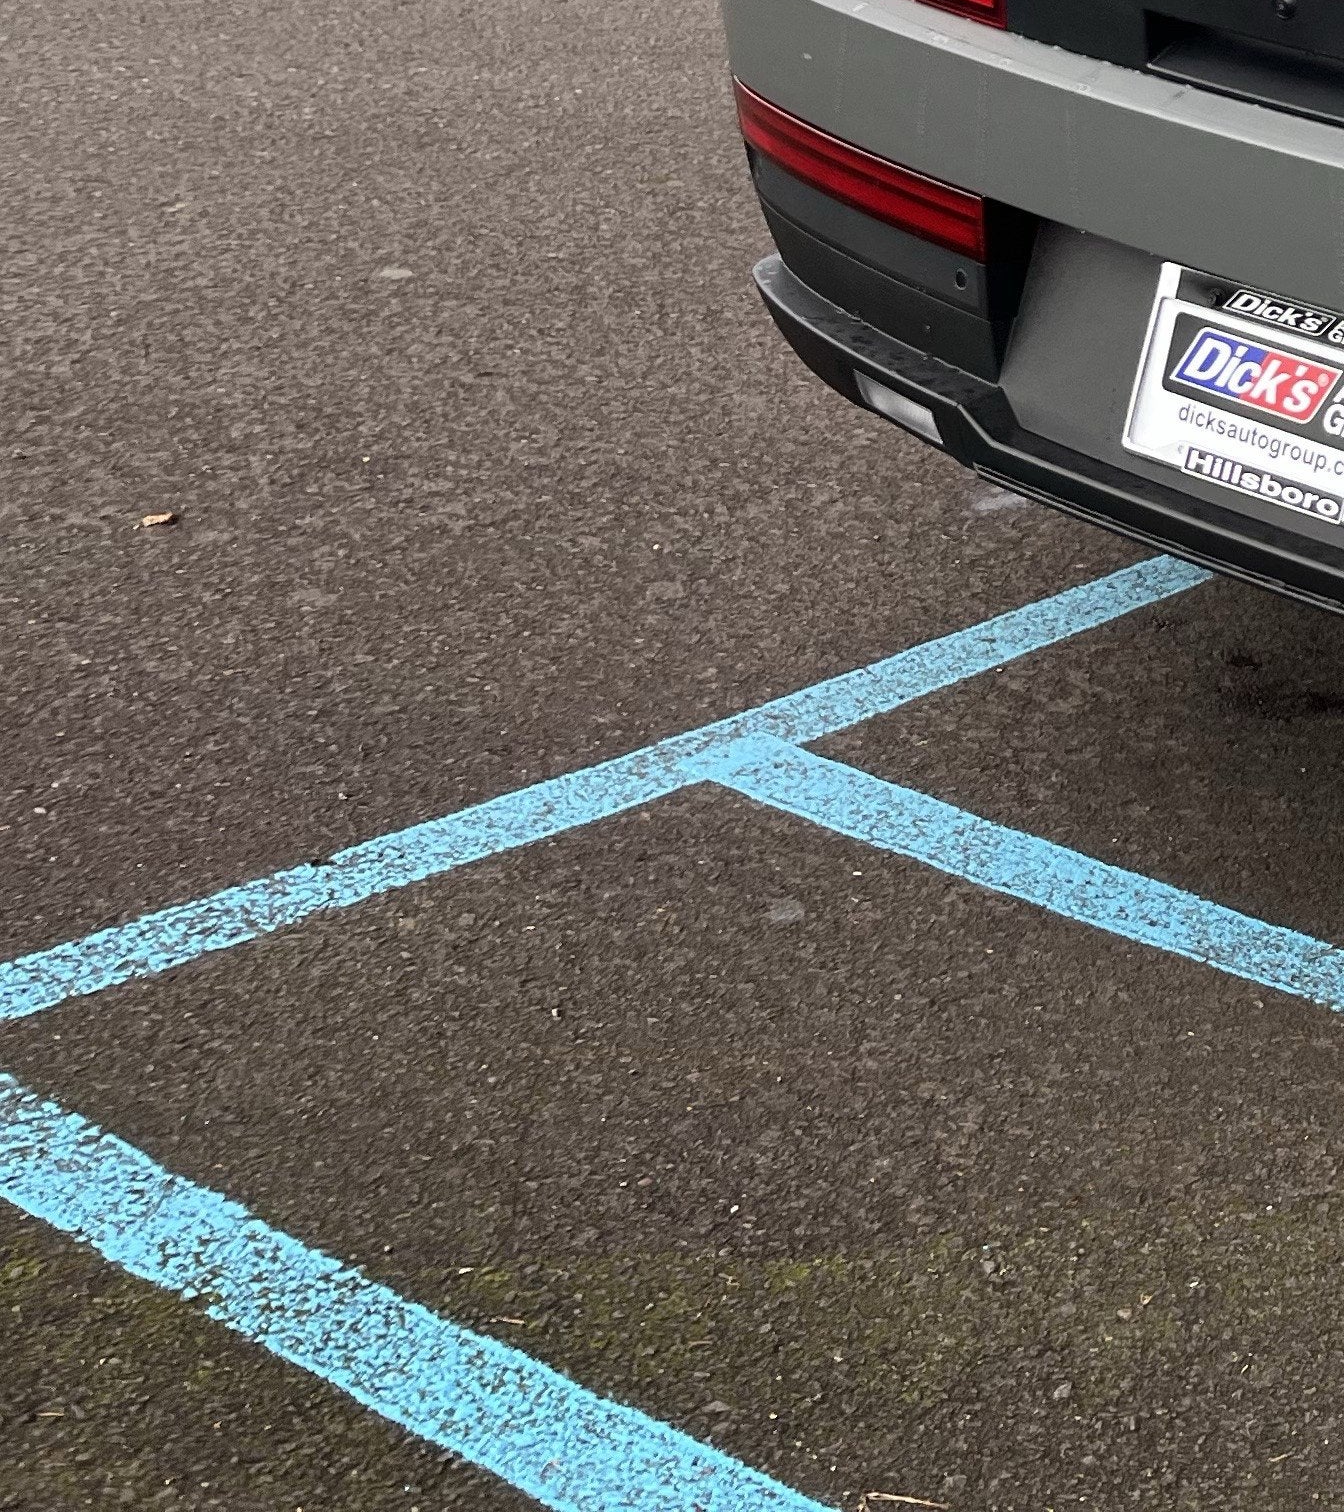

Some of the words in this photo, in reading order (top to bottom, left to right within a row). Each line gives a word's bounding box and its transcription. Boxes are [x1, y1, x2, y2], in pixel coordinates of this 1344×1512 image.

[1230, 293, 1323, 332] Dick's
[1184, 336, 1319, 414] Dick's
[1186, 446, 1340, 519] Hillsboro
